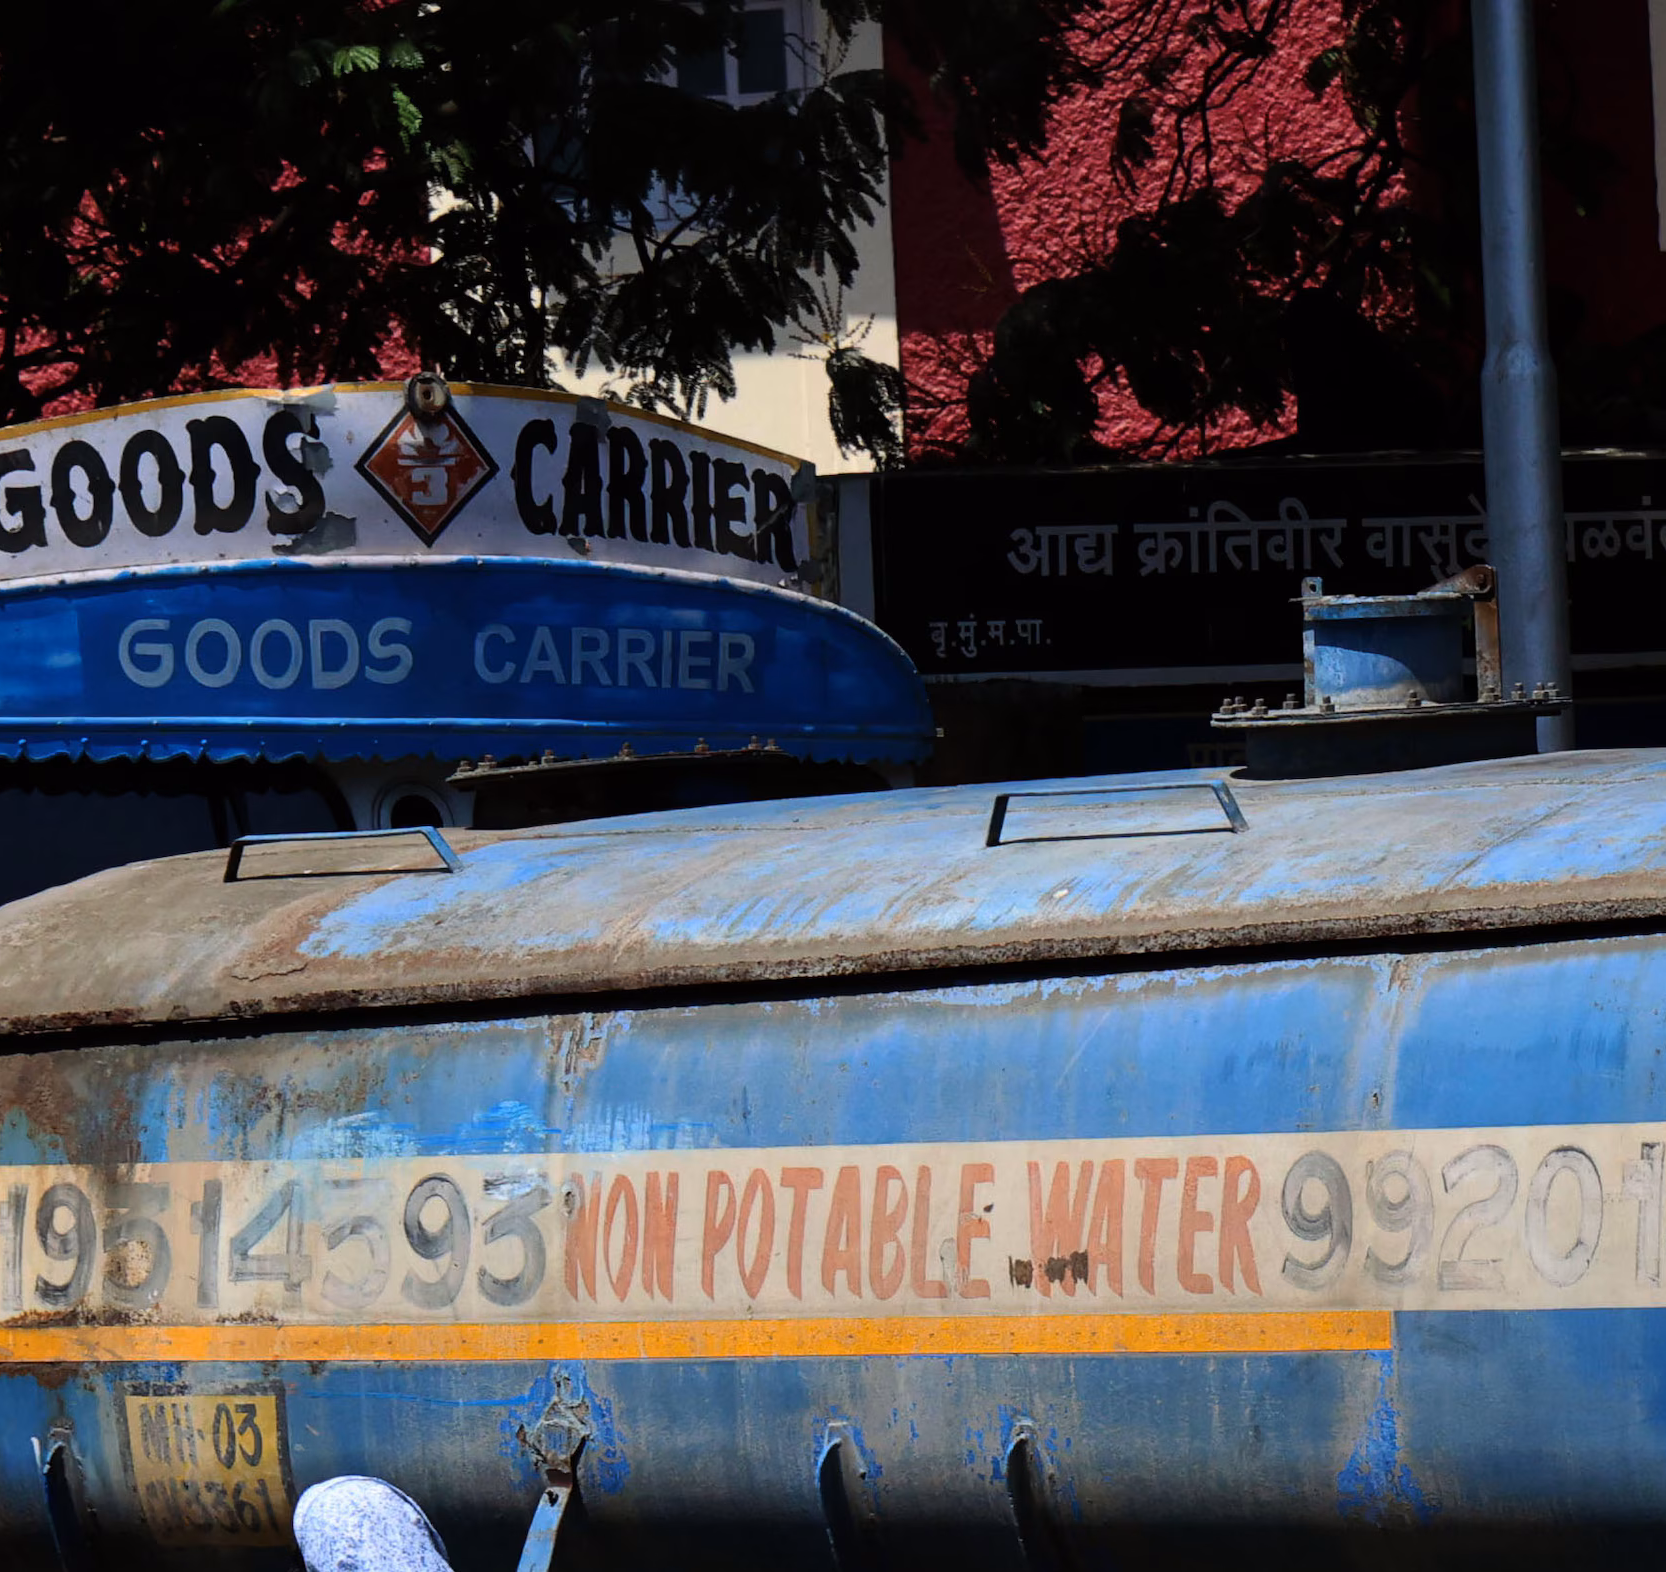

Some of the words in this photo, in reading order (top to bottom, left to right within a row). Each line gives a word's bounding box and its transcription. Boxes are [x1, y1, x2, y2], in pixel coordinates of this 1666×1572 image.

[511, 418, 798, 573] CARRIER
[1006, 522, 1120, 578] आद्य
[1132, 496, 1348, 577] क्रांतिवीर
[1361, 492, 1487, 582] वासुदे
[117, 616, 414, 691] GOODS
[473, 624, 757, 694] CARRIER
[564, 1170, 680, 1303] NON
[701, 1162, 995, 1300] POTABLE
[1027, 1155, 1263, 1297] WATER
